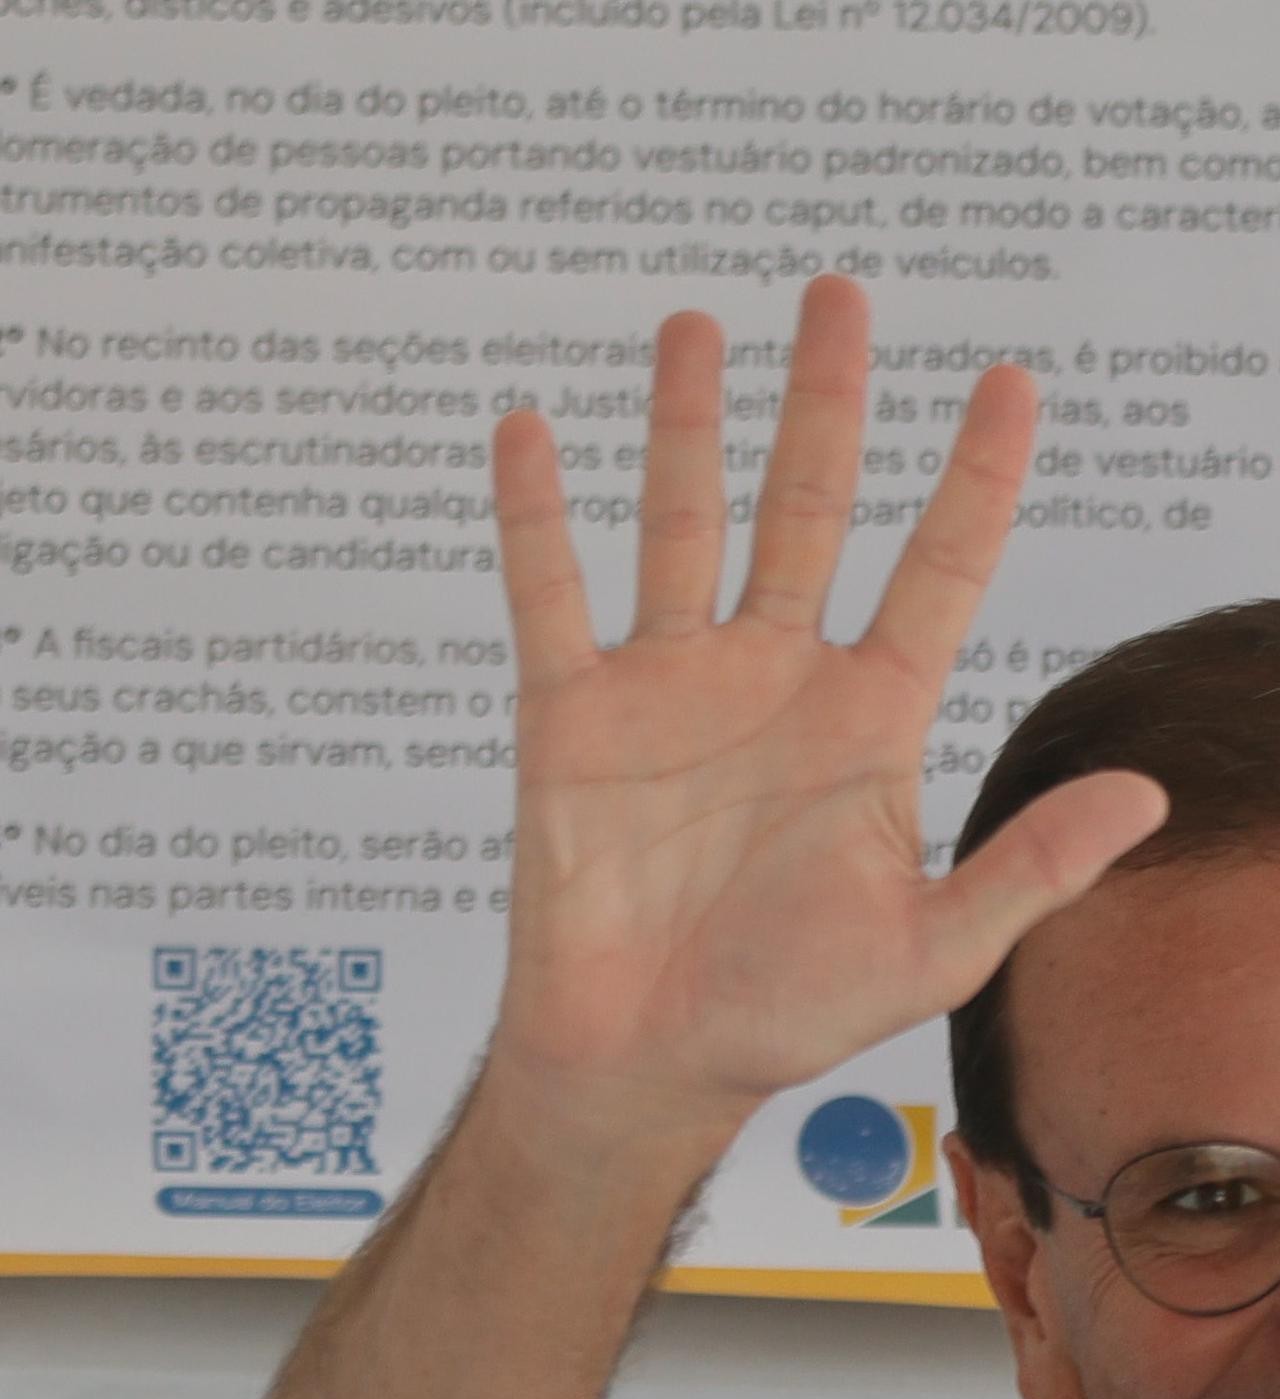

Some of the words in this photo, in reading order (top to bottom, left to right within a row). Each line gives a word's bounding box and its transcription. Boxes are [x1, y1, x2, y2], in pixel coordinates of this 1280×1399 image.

[681, 0, 762, 34] pela
[773, 0, 828, 30] Lei
[839, 0, 881, 28] nº
[29, 70, 51, 111] É
[64, 80, 214, 114] vedada,
[225, 87, 275, 114] no
[284, 83, 345, 115] dia
[355, 84, 407, 116] do
[417, 85, 533, 123] pleito,
[546, 87, 608, 119] até
[618, 94, 644, 120] o
[654, 89, 806, 123] término
[816, 91, 868, 123] do
[877, 92, 1016, 125] horário
[1027, 94, 1076, 127] de
[1087, 97, 1249, 138] votação,
[0, 135, 199, 173] omeração
[208, 133, 259, 166] de
[269, 140, 430, 171] pessoas
[440, 140, 621, 174] portando
[632, 141, 813, 174] vestuário
[822, 145, 1071, 179] padronizado,
[1082, 146, 1168, 179] bem
[214, 186, 263, 217] de
[274, 190, 508, 229] propaganda
[519, 189, 694, 224] referidos
[704, 198, 754, 225] no
[764, 197, 888, 231] caput,
[898, 195, 949, 227] de
[959, 197, 1072, 229] modo
[1081, 203, 1105, 229] a
[0, 234, 209, 276] nifestação
[218, 238, 379, 271] coletiva,
[390, 245, 476, 271] com
[487, 246, 536, 273] ou
[547, 247, 628, 274] sem
[639, 244, 823, 286] utilização
[834, 246, 884, 278] de
[894, 246, 1058, 280] veículos.
[36, 327, 91, 359] No
[101, 329, 240, 361] recinto
[250, 330, 321, 363] das
[332, 331, 470, 373] seções
[480, 334, 652, 367] eleitorais
[1073, 341, 1098, 373] é
[1108, 343, 1269, 379] proibido
[159, 385, 184, 413] e
[195, 386, 264, 413] aos
[276, 380, 479, 416] servidores
[490, 386, 538, 413] da
[875, 391, 918, 423] às
[1122, 400, 1190, 427] aos
[0, 429, 127, 465] sários,
[139, 431, 184, 464] às
[193, 435, 488, 468] escrutinadoras
[560, 443, 603, 470] os
[917, 448, 940, 475] o
[1035, 445, 1083, 477] de
[1094, 446, 1273, 479] vestuário
[0, 483, 69, 517] eto
[79, 488, 153, 522] que
[163, 486, 349, 518] contenha
[359, 488, 492, 526] qualqu
[1162, 498, 1212, 530] de
[140, 541, 191, 568] ou
[201, 537, 251, 569] de
[34, 627, 61, 657] A
[72, 627, 195, 661] fiscais
[205, 632, 426, 666] partidários,
[438, 639, 507, 666] nos
[1005, 640, 1029, 672] é
[12, 685, 101, 712] seus
[112, 681, 275, 714] crachás,
[287, 687, 456, 716] constem
[468, 691, 492, 717] o
[138, 738, 161, 764] a
[171, 738, 246, 772] que
[257, 736, 392, 769] sirvam,
[405, 738, 515, 768] sendo
[34, 824, 88, 857] No
[98, 825, 158, 857] dia
[169, 826, 220, 858] do
[231, 827, 348, 865] pleito,
[361, 829, 469, 861] serão
[0, 876, 77, 908] veis
[89, 882, 157, 909] nas
[168, 881, 294, 915] partes
[306, 880, 443, 912] interna
[453, 886, 477, 913] e
